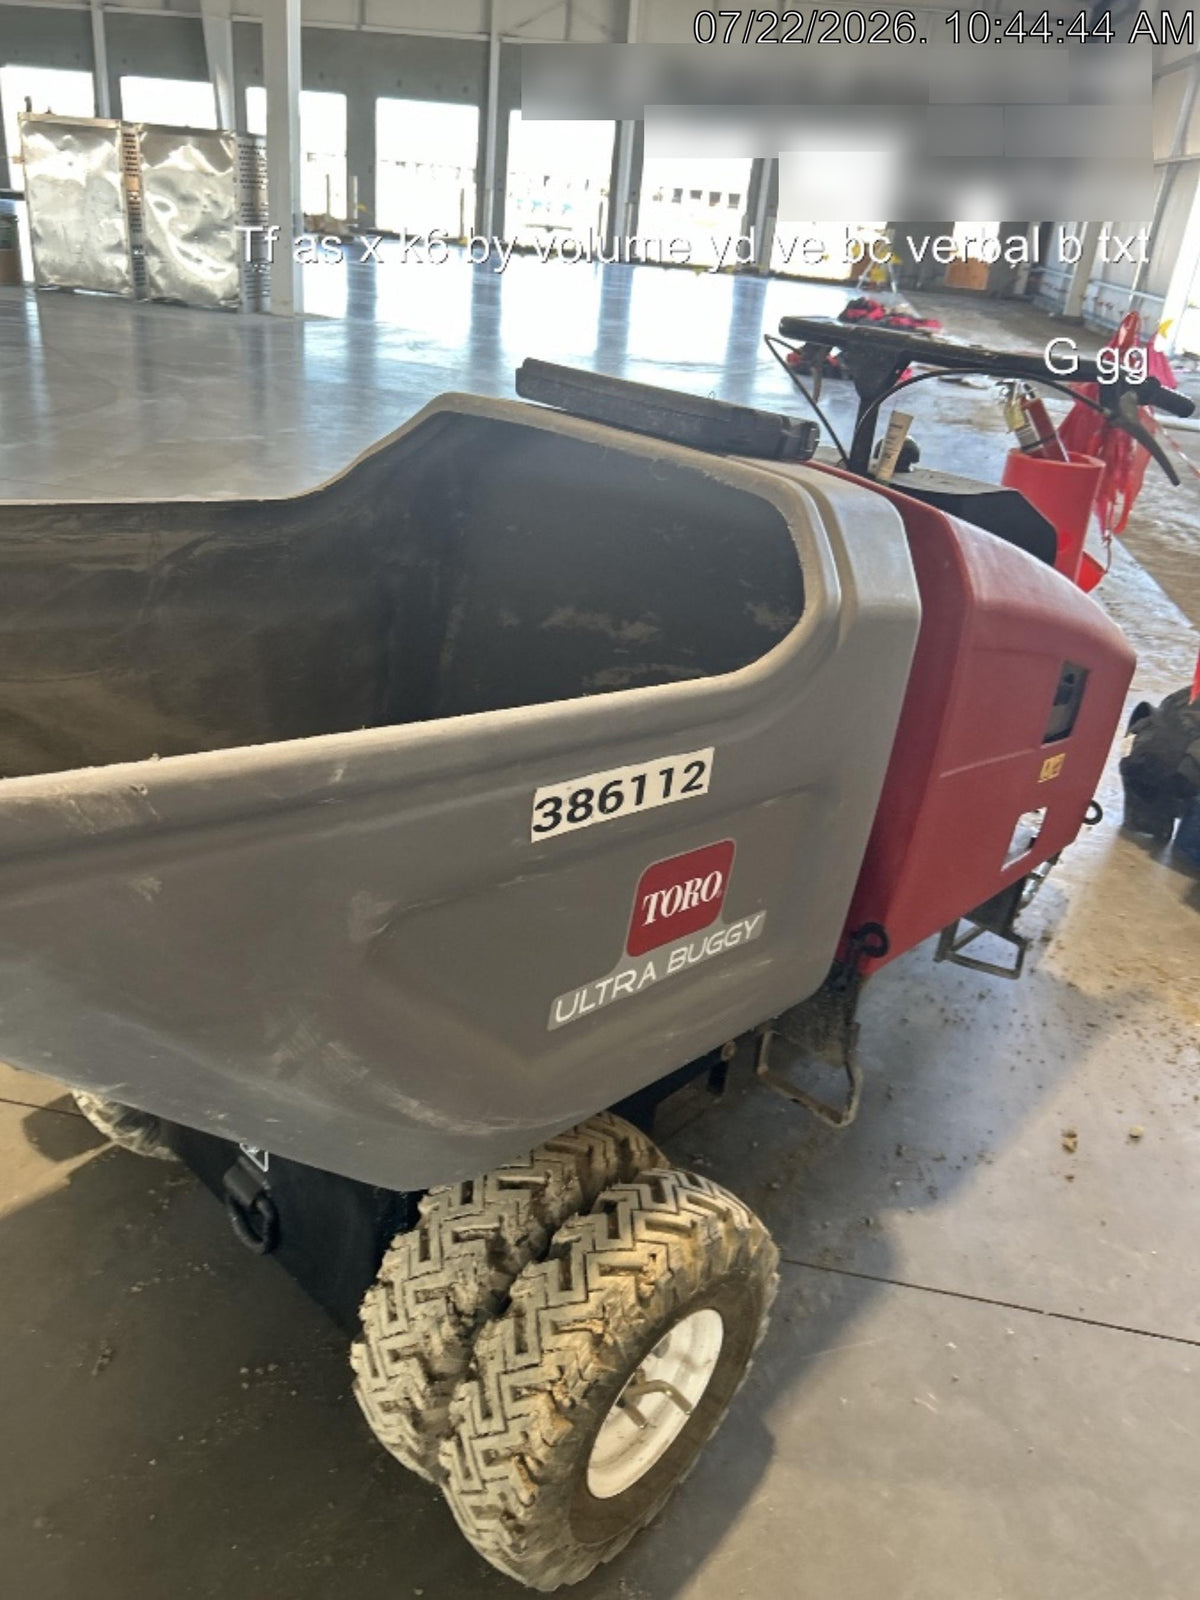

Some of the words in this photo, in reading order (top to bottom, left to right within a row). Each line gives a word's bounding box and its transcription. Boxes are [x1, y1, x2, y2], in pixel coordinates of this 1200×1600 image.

[532, 760, 706, 834] 386112
[641, 870, 723, 927] TORO
[555, 961, 657, 1023] ULTRA
[667, 914, 761, 974] BUGGY
